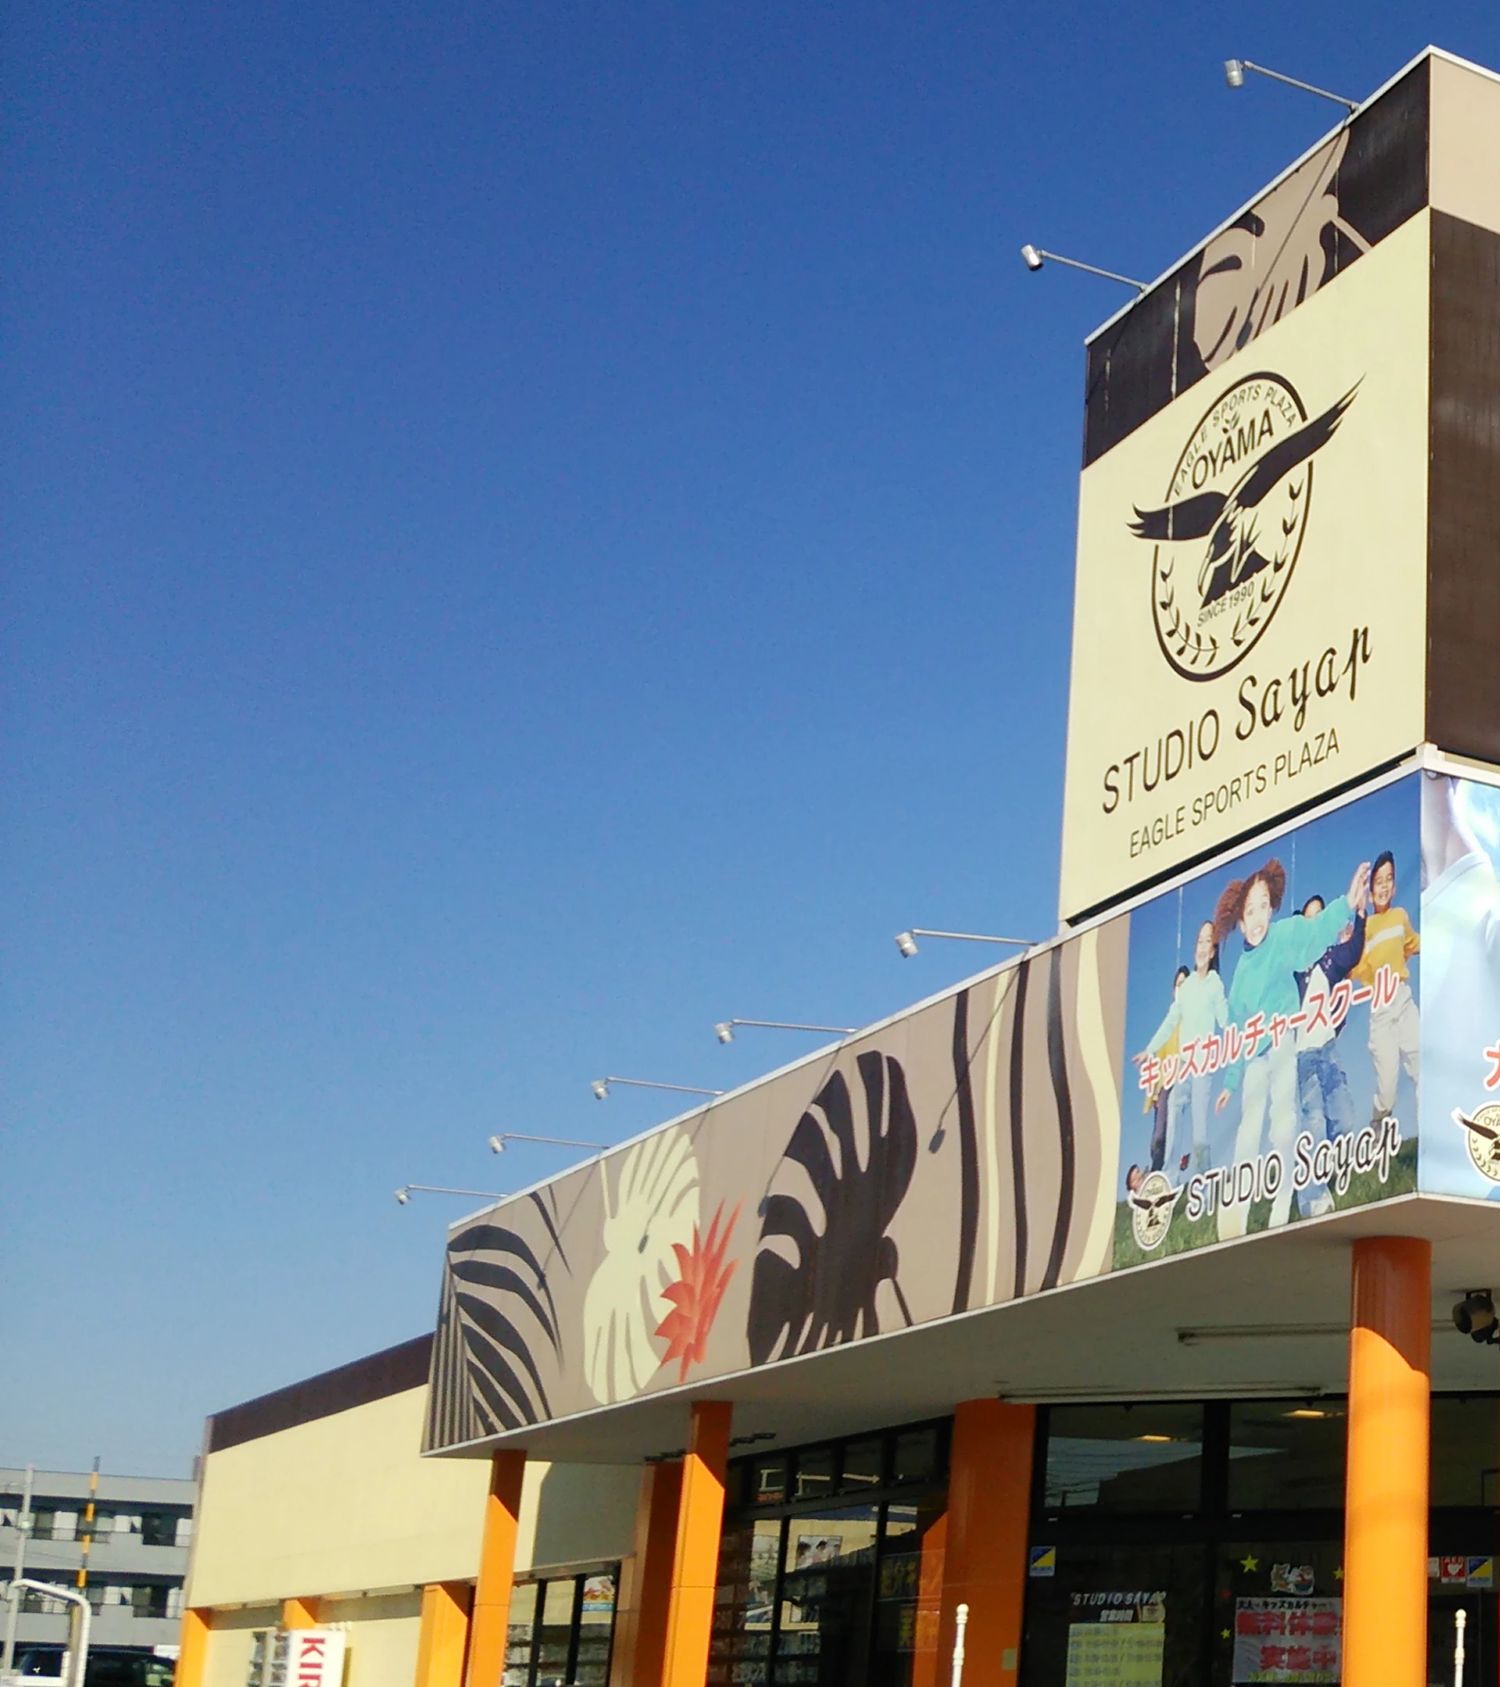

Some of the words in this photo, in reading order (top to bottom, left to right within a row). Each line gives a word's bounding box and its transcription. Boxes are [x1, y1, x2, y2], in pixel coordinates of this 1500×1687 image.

[1192, 408, 1274, 490] OYAMA
[1213, 384, 1262, 427] SPORTS
[1264, 386, 1297, 428] PLAZA
[1229, 581, 1255, 608] 1990
[1102, 707, 1220, 814] STUDIO
[1235, 626, 1373, 741] Sayap
[1129, 806, 1185, 858] EAGLE
[1191, 765, 1267, 827] SPORTS
[1274, 727, 1340, 789] PLAZA
[1140, 967, 1399, 1094] キッズカルチャースクール
[1187, 1154, 1282, 1217] STUDIO
[1294, 1118, 1400, 1192] Sayap
